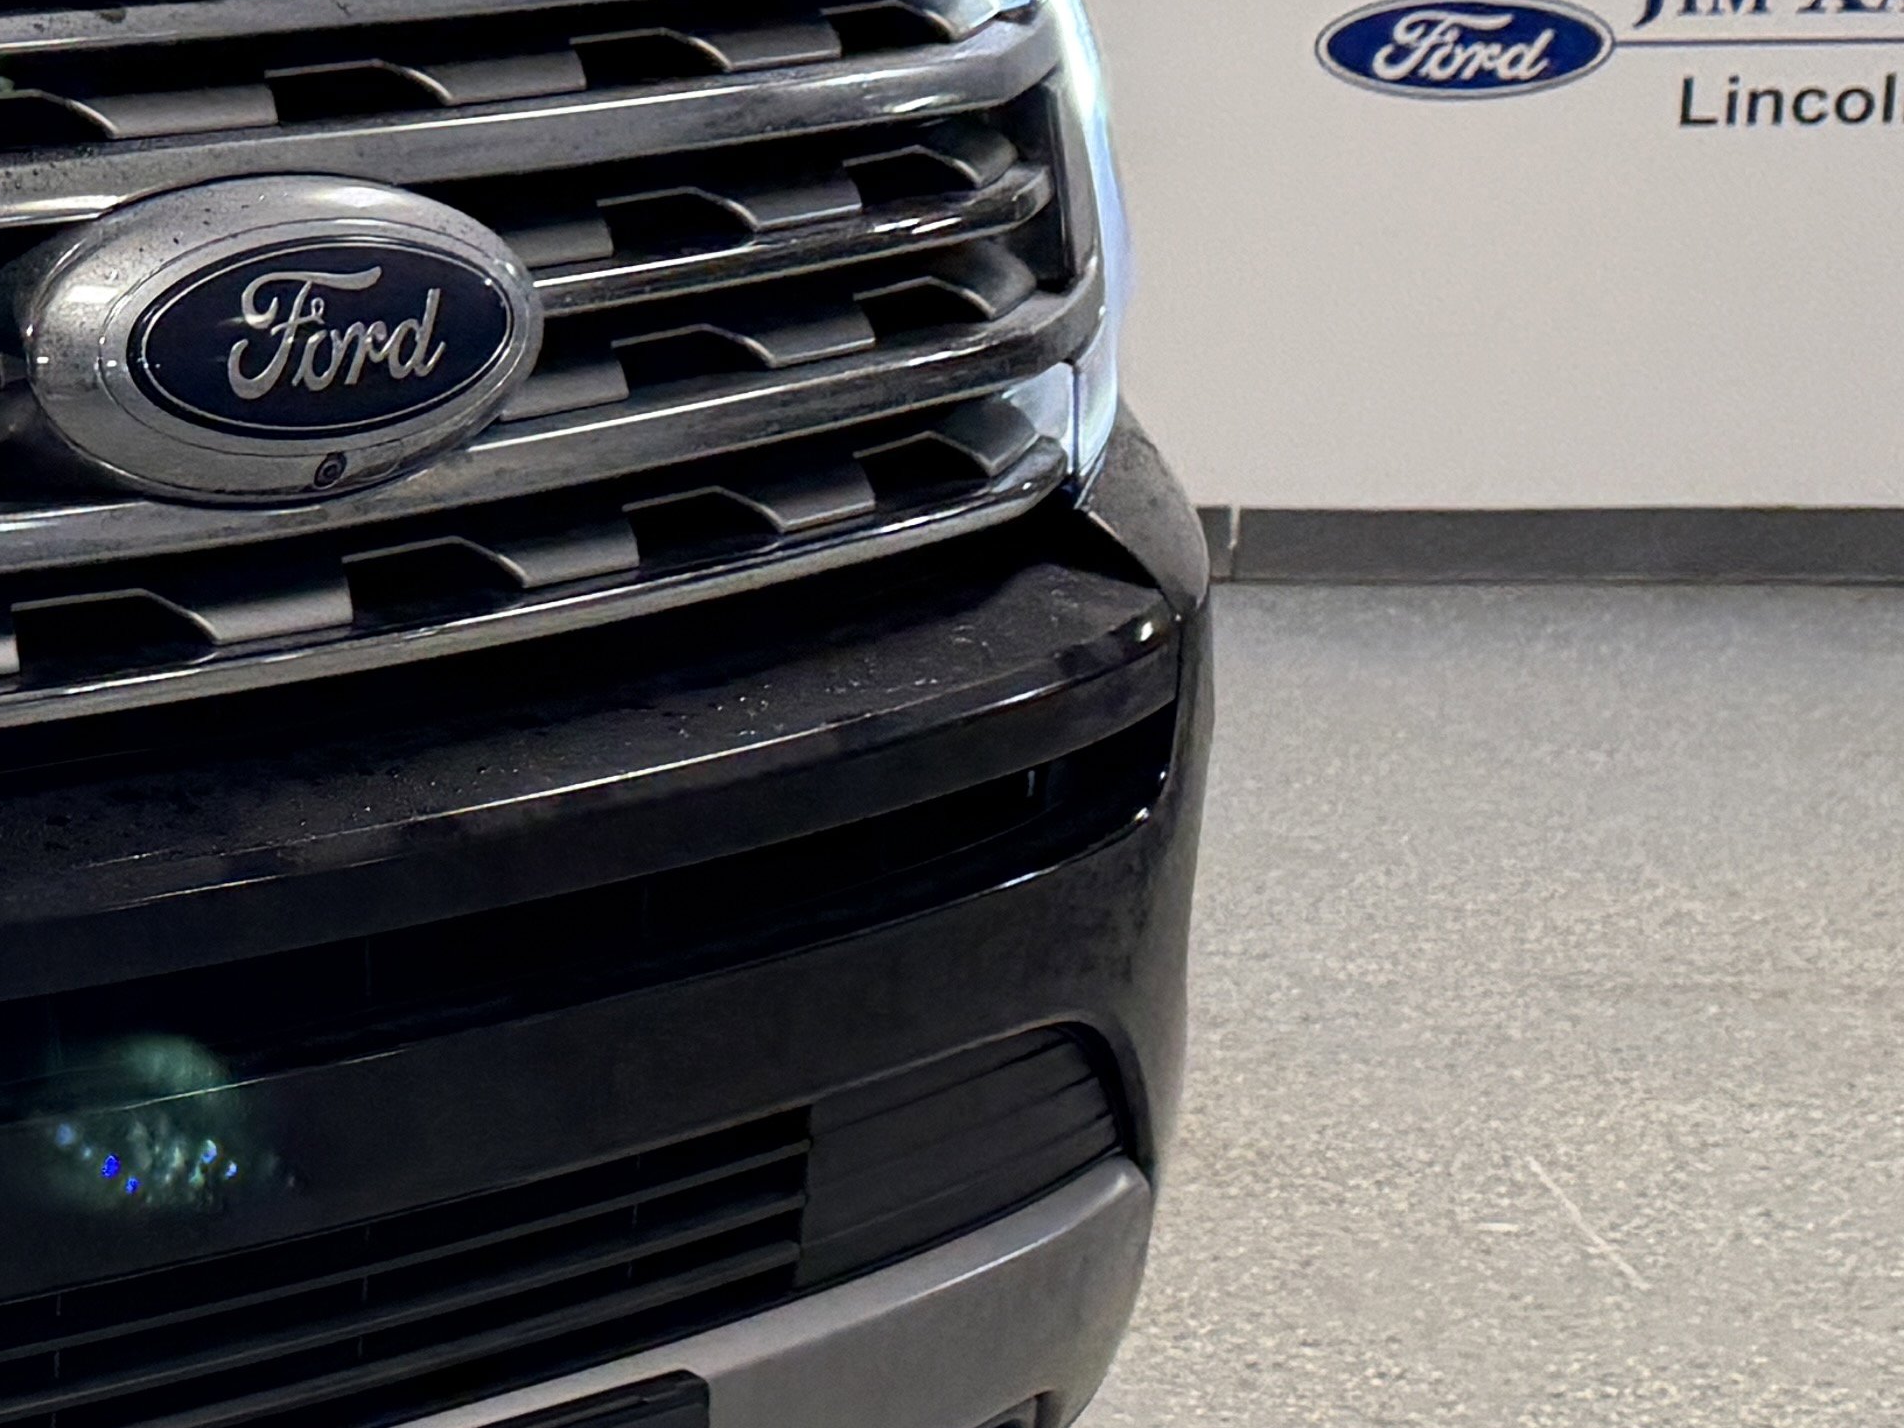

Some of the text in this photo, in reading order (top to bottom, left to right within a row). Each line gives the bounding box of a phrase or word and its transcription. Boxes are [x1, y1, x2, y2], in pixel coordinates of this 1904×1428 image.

[1373, 11, 1556, 81] Ford
[1679, 72, 1904, 127] Lincol
[227, 266, 446, 400] Ford
